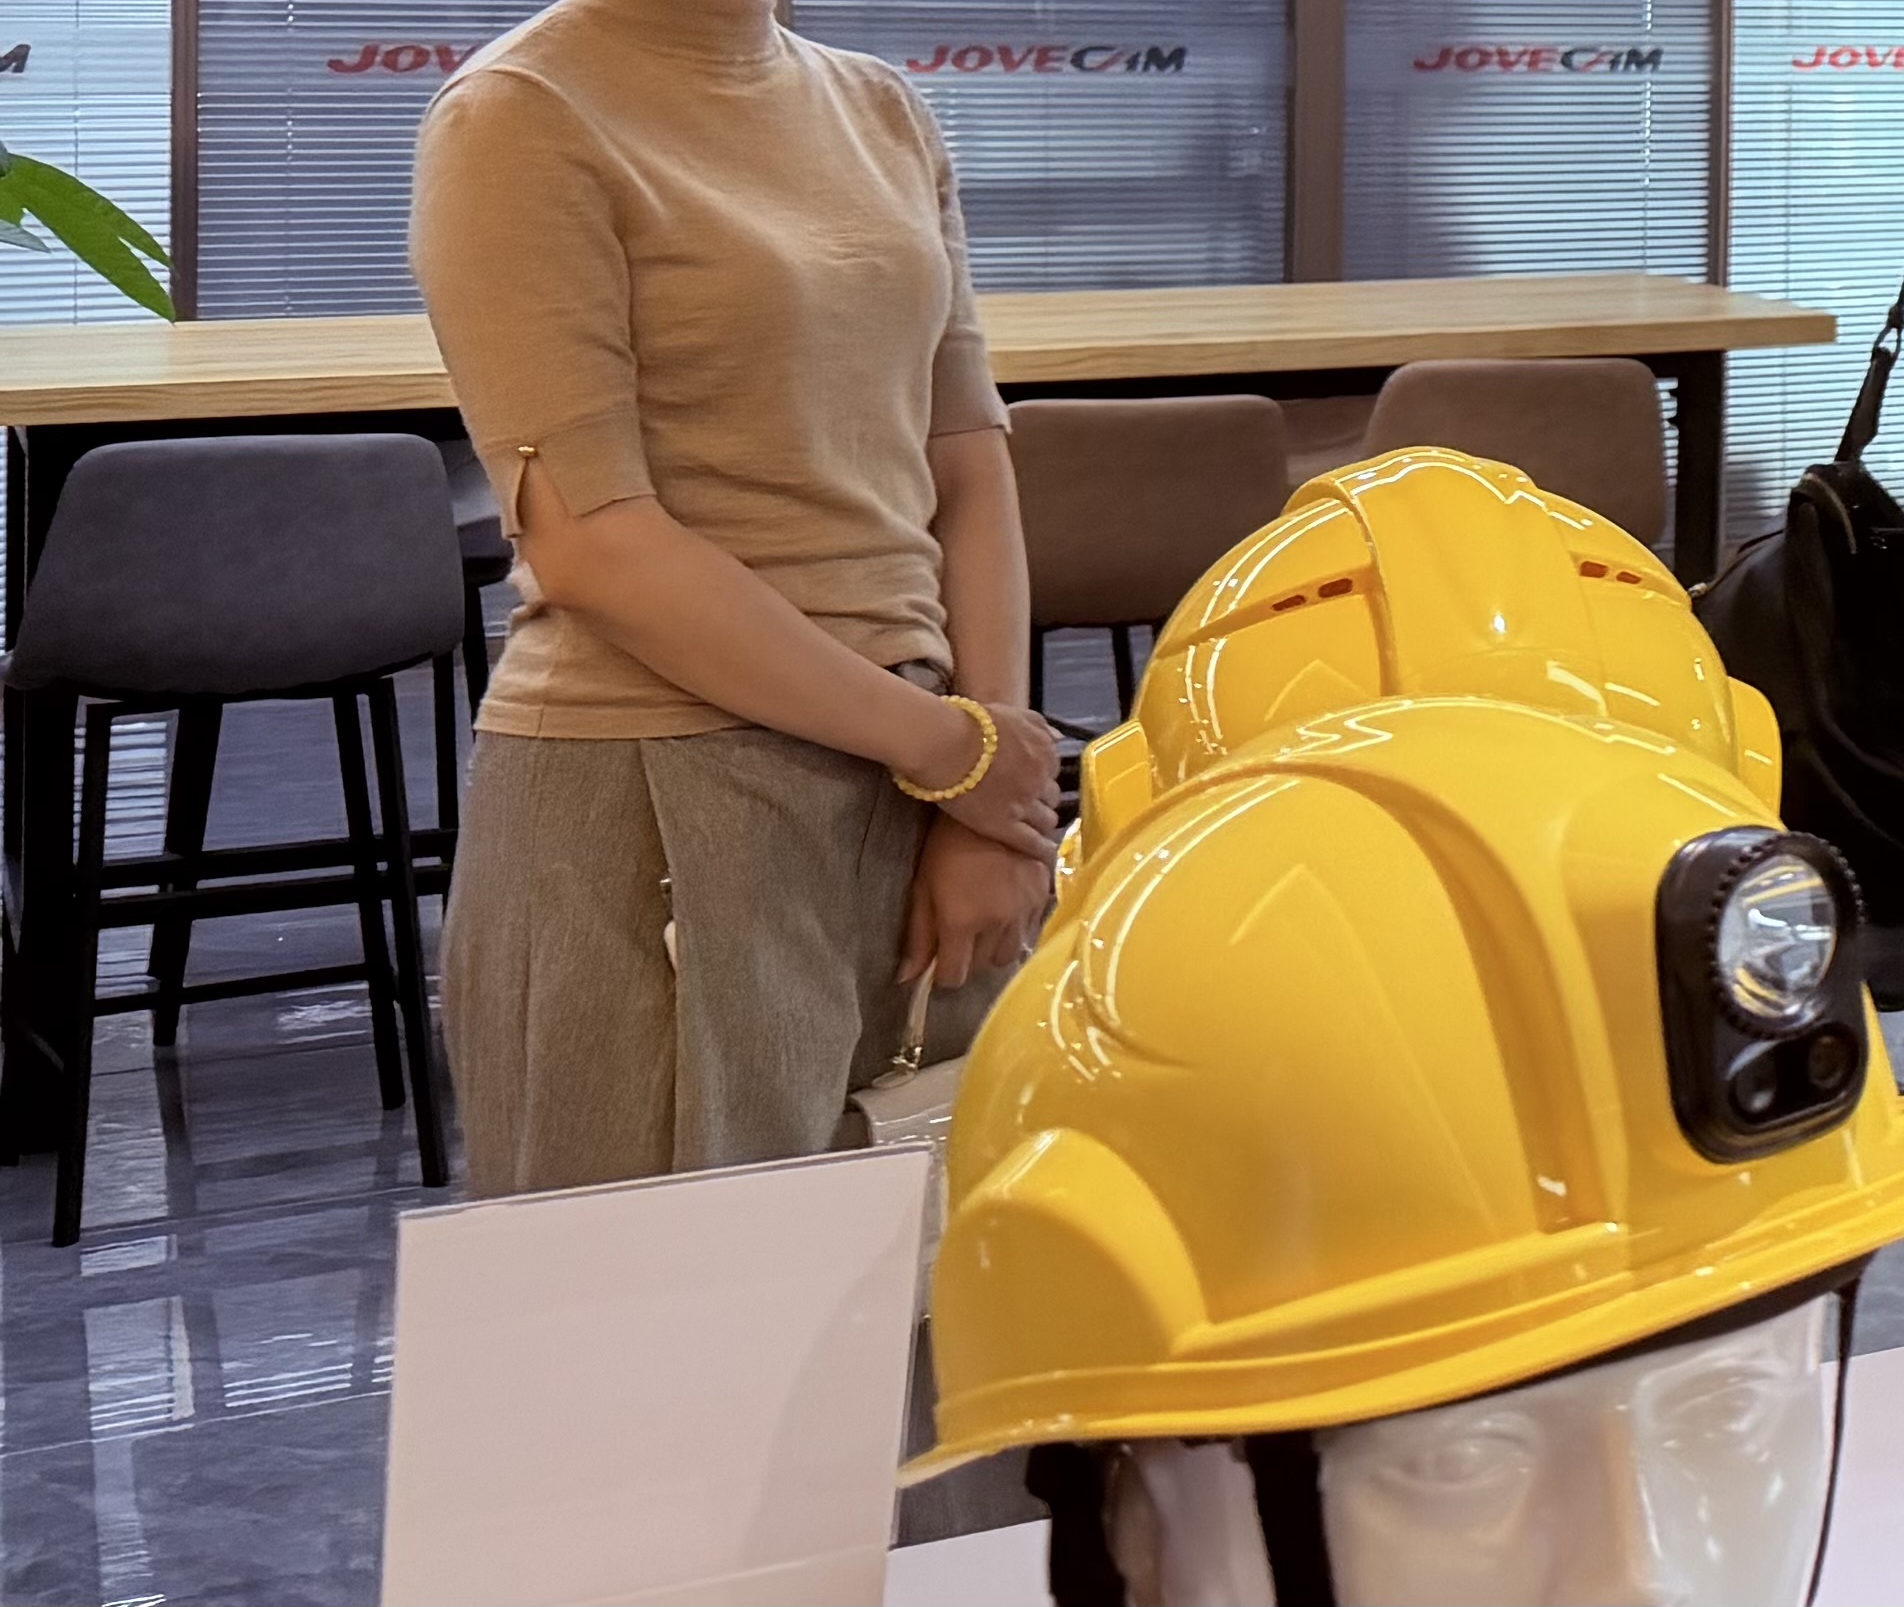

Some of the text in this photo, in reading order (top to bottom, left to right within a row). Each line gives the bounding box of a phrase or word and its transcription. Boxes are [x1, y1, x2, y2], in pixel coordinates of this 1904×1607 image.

[327, 44, 481, 74] JOV
[905, 45, 1188, 73] JOVECAM
[1413, 47, 1664, 73] JOVECAM
